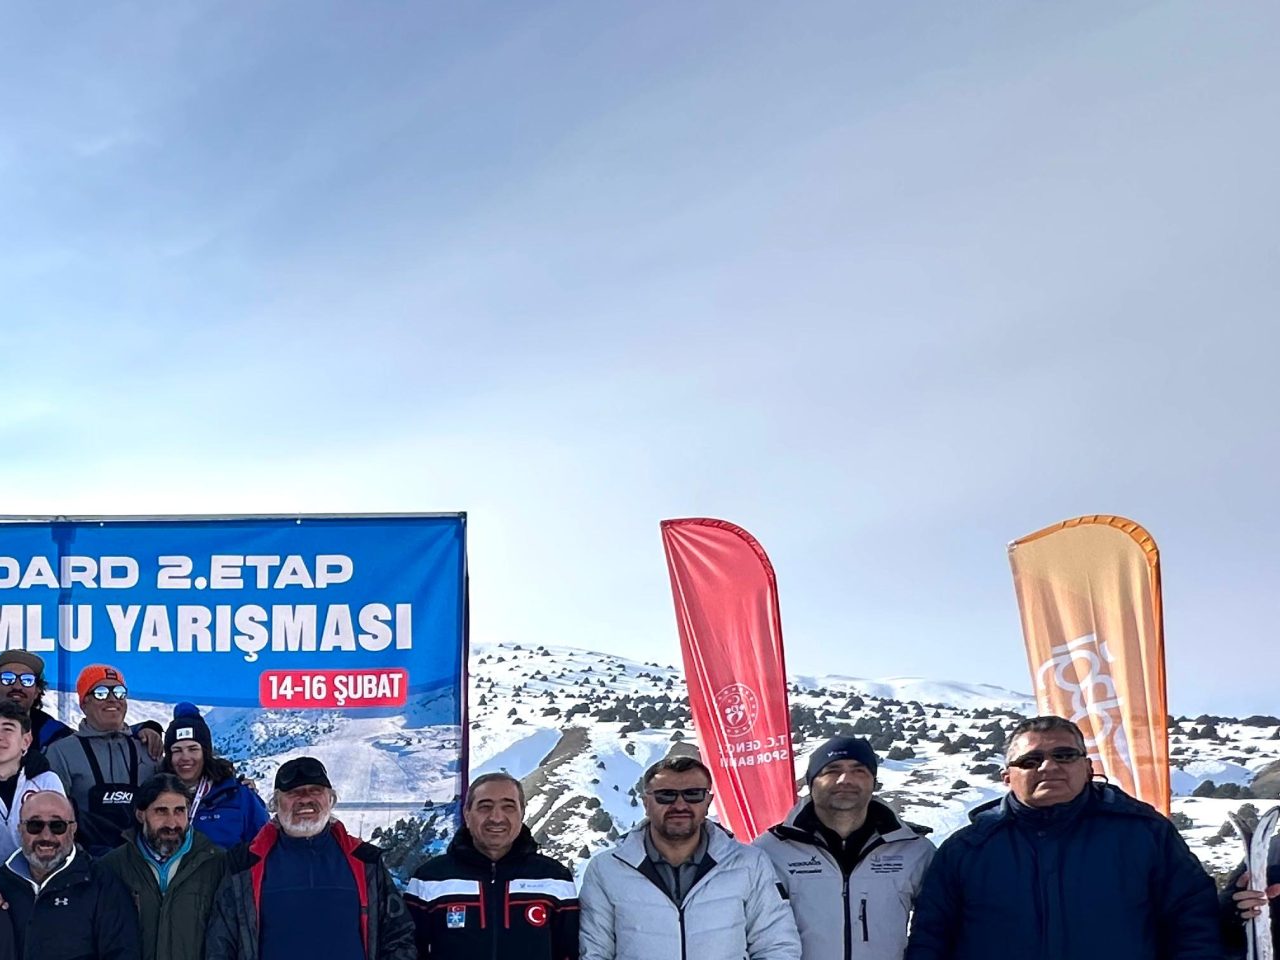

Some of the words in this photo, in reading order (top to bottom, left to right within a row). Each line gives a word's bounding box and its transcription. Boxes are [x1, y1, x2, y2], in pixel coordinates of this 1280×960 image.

[157, 553, 354, 590] 2.ETAP
[105, 603, 412, 663] YARIŞMASI
[268, 674, 327, 701] 14-16
[333, 672, 404, 706] ŞUBAT
[102, 791, 134, 801] LISKI
